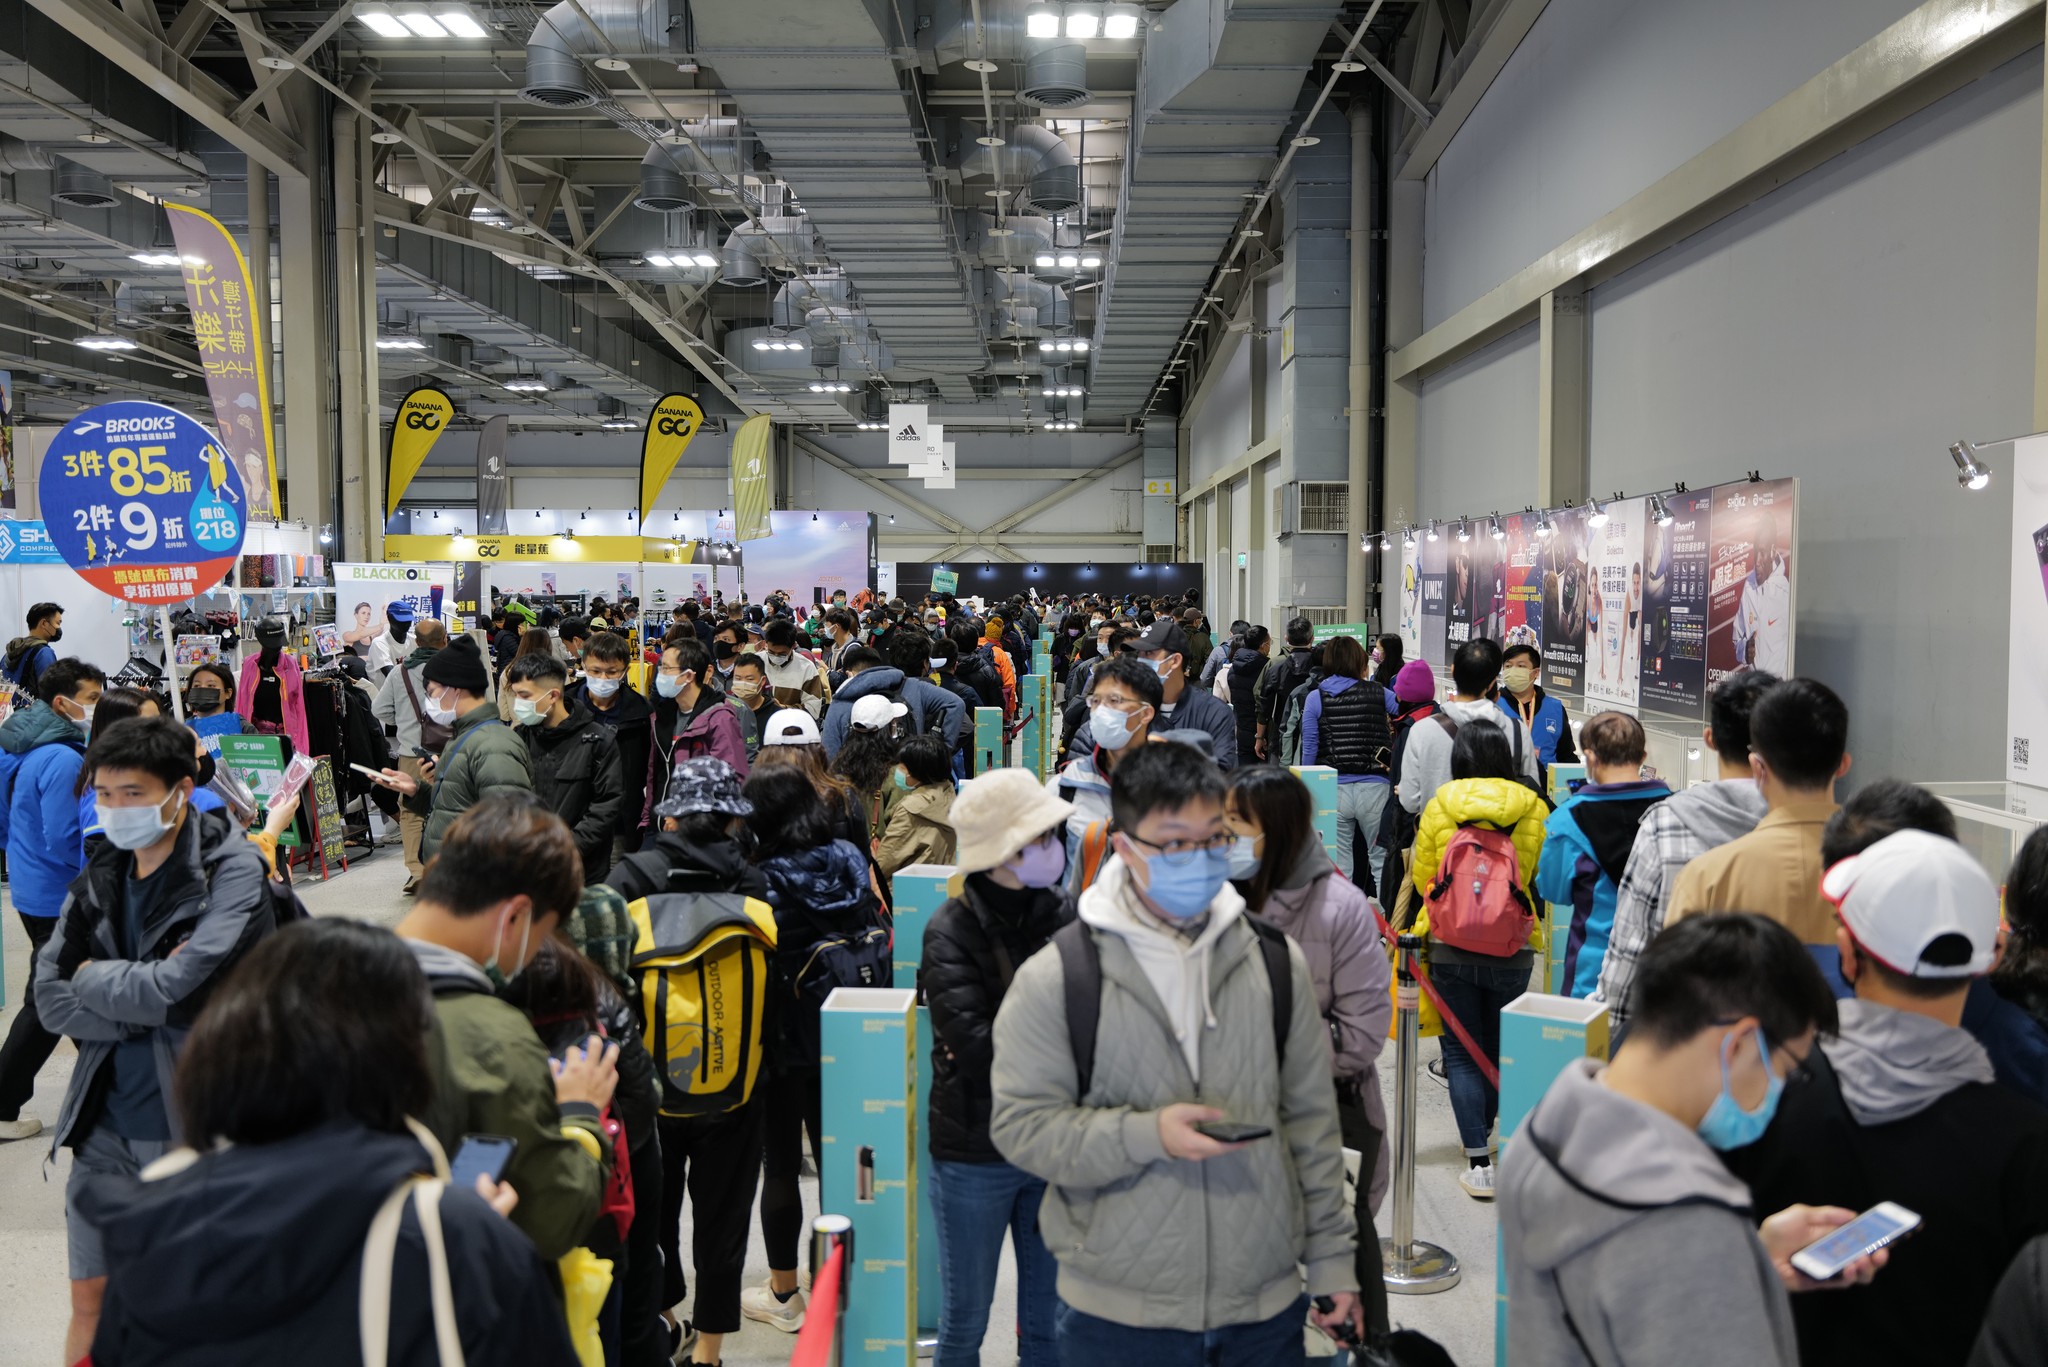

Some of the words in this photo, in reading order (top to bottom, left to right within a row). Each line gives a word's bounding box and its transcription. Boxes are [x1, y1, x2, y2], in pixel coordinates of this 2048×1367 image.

[407, 402, 443, 411] BANANA
[658, 407, 693, 417] BANANA
[105, 416, 175, 433] BROOKS
[406, 411, 440, 431] GO
[658, 417, 691, 437] GO
[1148, 481, 1158, 493] C
[1164, 482, 1171, 493] 1
[19, 528, 52, 542] SH
[195, 520, 237, 540] 218
[477, 545, 500, 557] GO
[514, 543, 549, 555] 能量蕉
[113, 565, 198, 585] 憑號碼布消費
[353, 567, 431, 581] BLACKROLL
[123, 582, 195, 599] 享折扣優惠
[1425, 580, 1443, 600] UNIX
[709, 960, 724, 1074] OUTDOOR-ACTIVE
